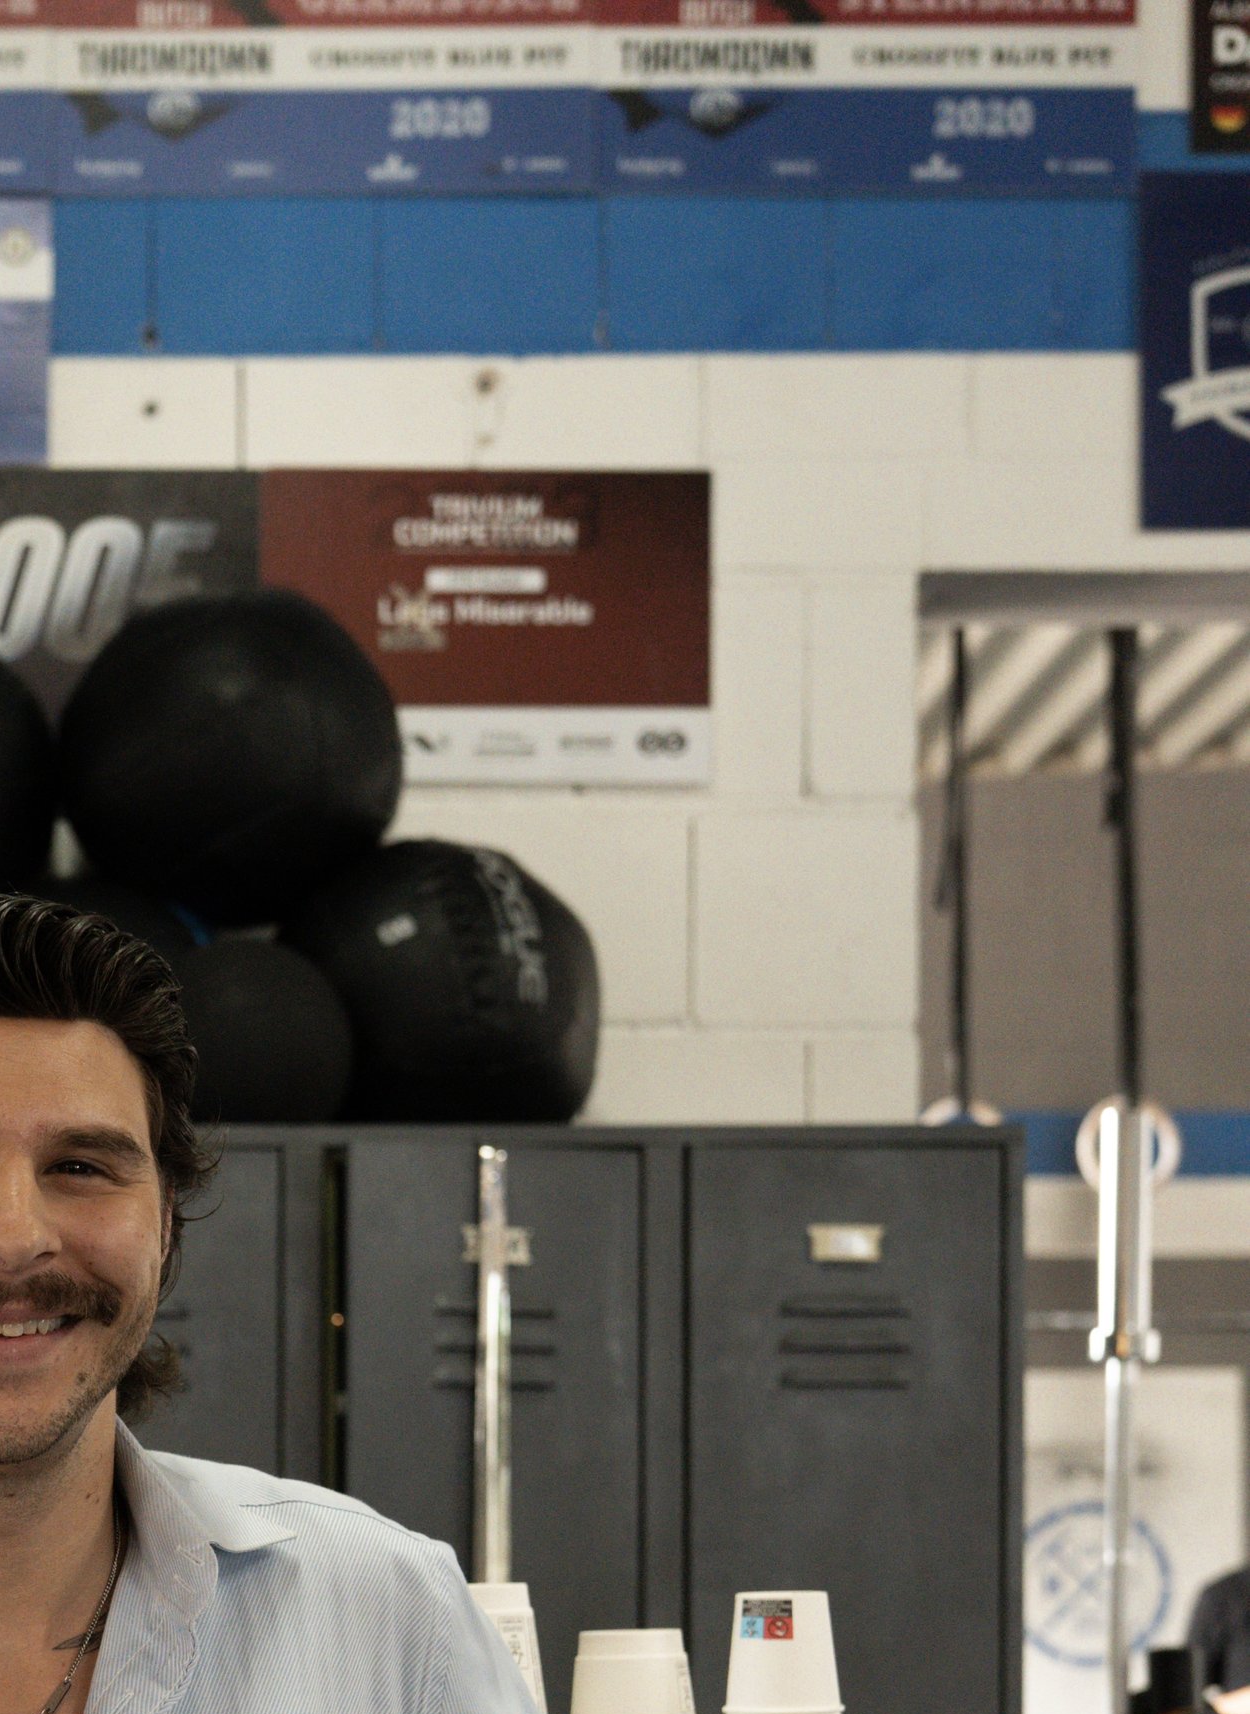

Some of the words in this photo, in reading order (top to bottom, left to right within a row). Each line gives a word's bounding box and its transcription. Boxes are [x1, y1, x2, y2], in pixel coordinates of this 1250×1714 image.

[79, 42, 272, 76] THROWDOWN
[448, 47, 511, 68] BLUE
[522, 46, 567, 67] PIT
[620, 40, 815, 74] THROWDOWN
[990, 46, 1054, 68] BLUE
[1067, 46, 1112, 66] PIT
[390, 99, 491, 139] 2020
[932, 98, 1034, 137] 2020
[429, 494, 544, 519] TRIVIUM
[393, 519, 579, 547] COMPETITION
